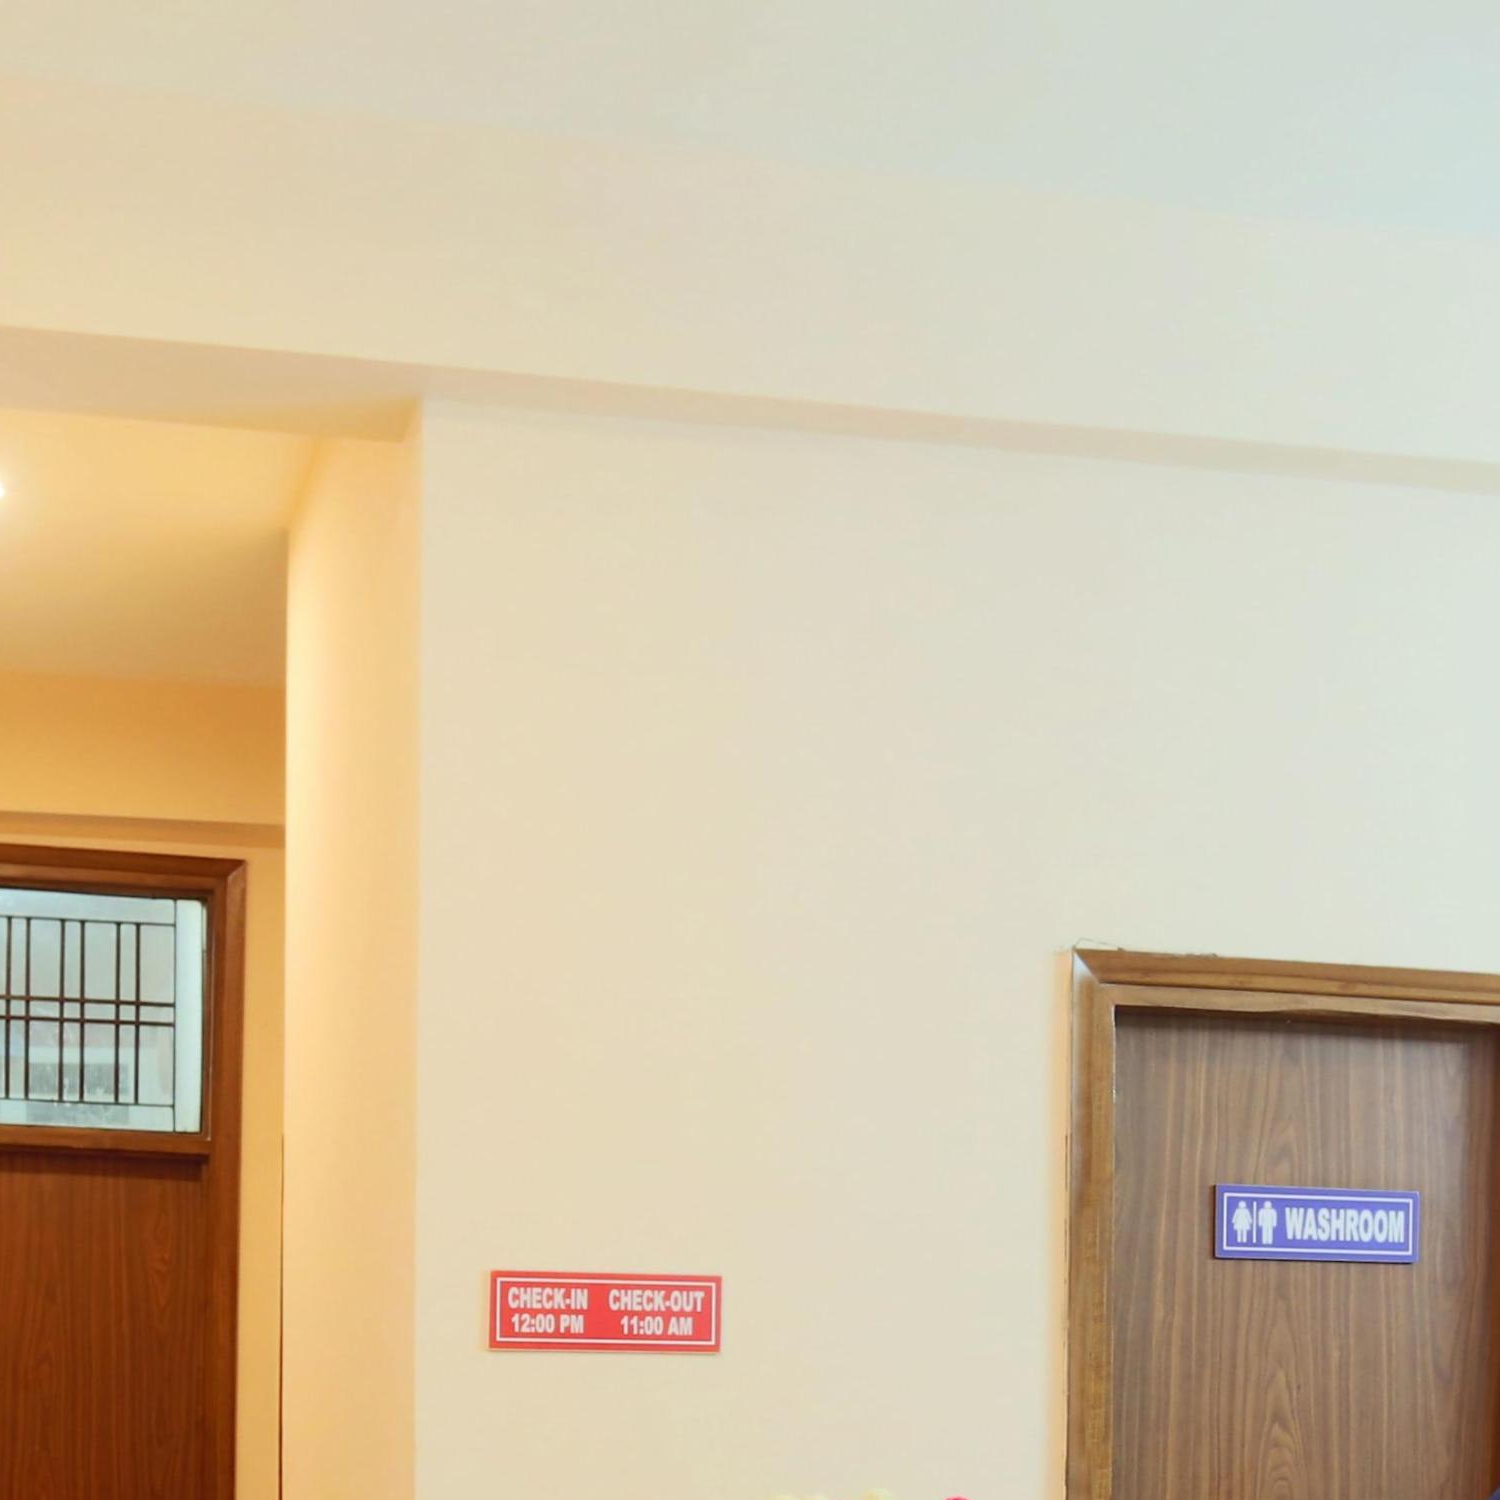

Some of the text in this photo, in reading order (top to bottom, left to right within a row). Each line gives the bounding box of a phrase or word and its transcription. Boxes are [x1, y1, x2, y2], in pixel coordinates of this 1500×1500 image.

[1284, 1207, 1405, 1243] WASHROOM
[507, 1286, 588, 1310] CHECK-IN
[608, 1289, 705, 1312] CHECK-OUT
[511, 1313, 585, 1334] 12:00 PM
[620, 1315, 693, 1336] 11:00 AM
